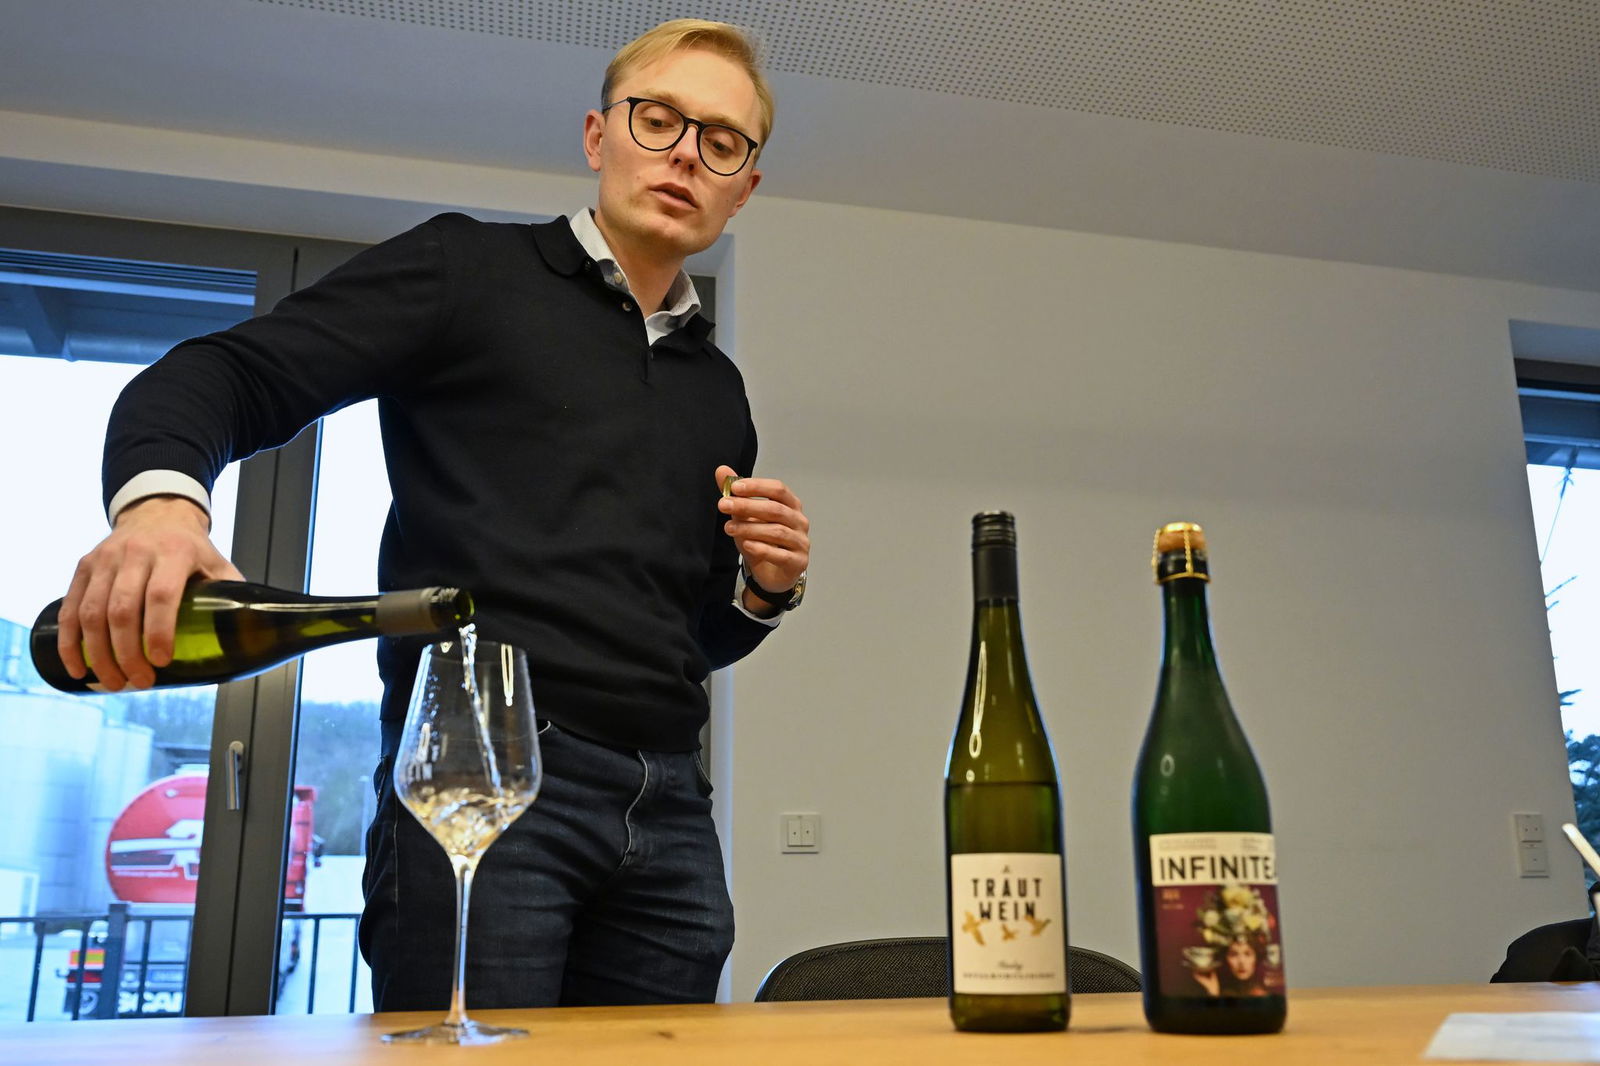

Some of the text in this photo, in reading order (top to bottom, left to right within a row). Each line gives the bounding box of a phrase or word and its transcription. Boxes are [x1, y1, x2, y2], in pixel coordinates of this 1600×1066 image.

[1159, 856, 1278, 880] INFINITE
[972, 878, 1042, 898] TRAUT
[979, 902, 1036, 921] WEIN
